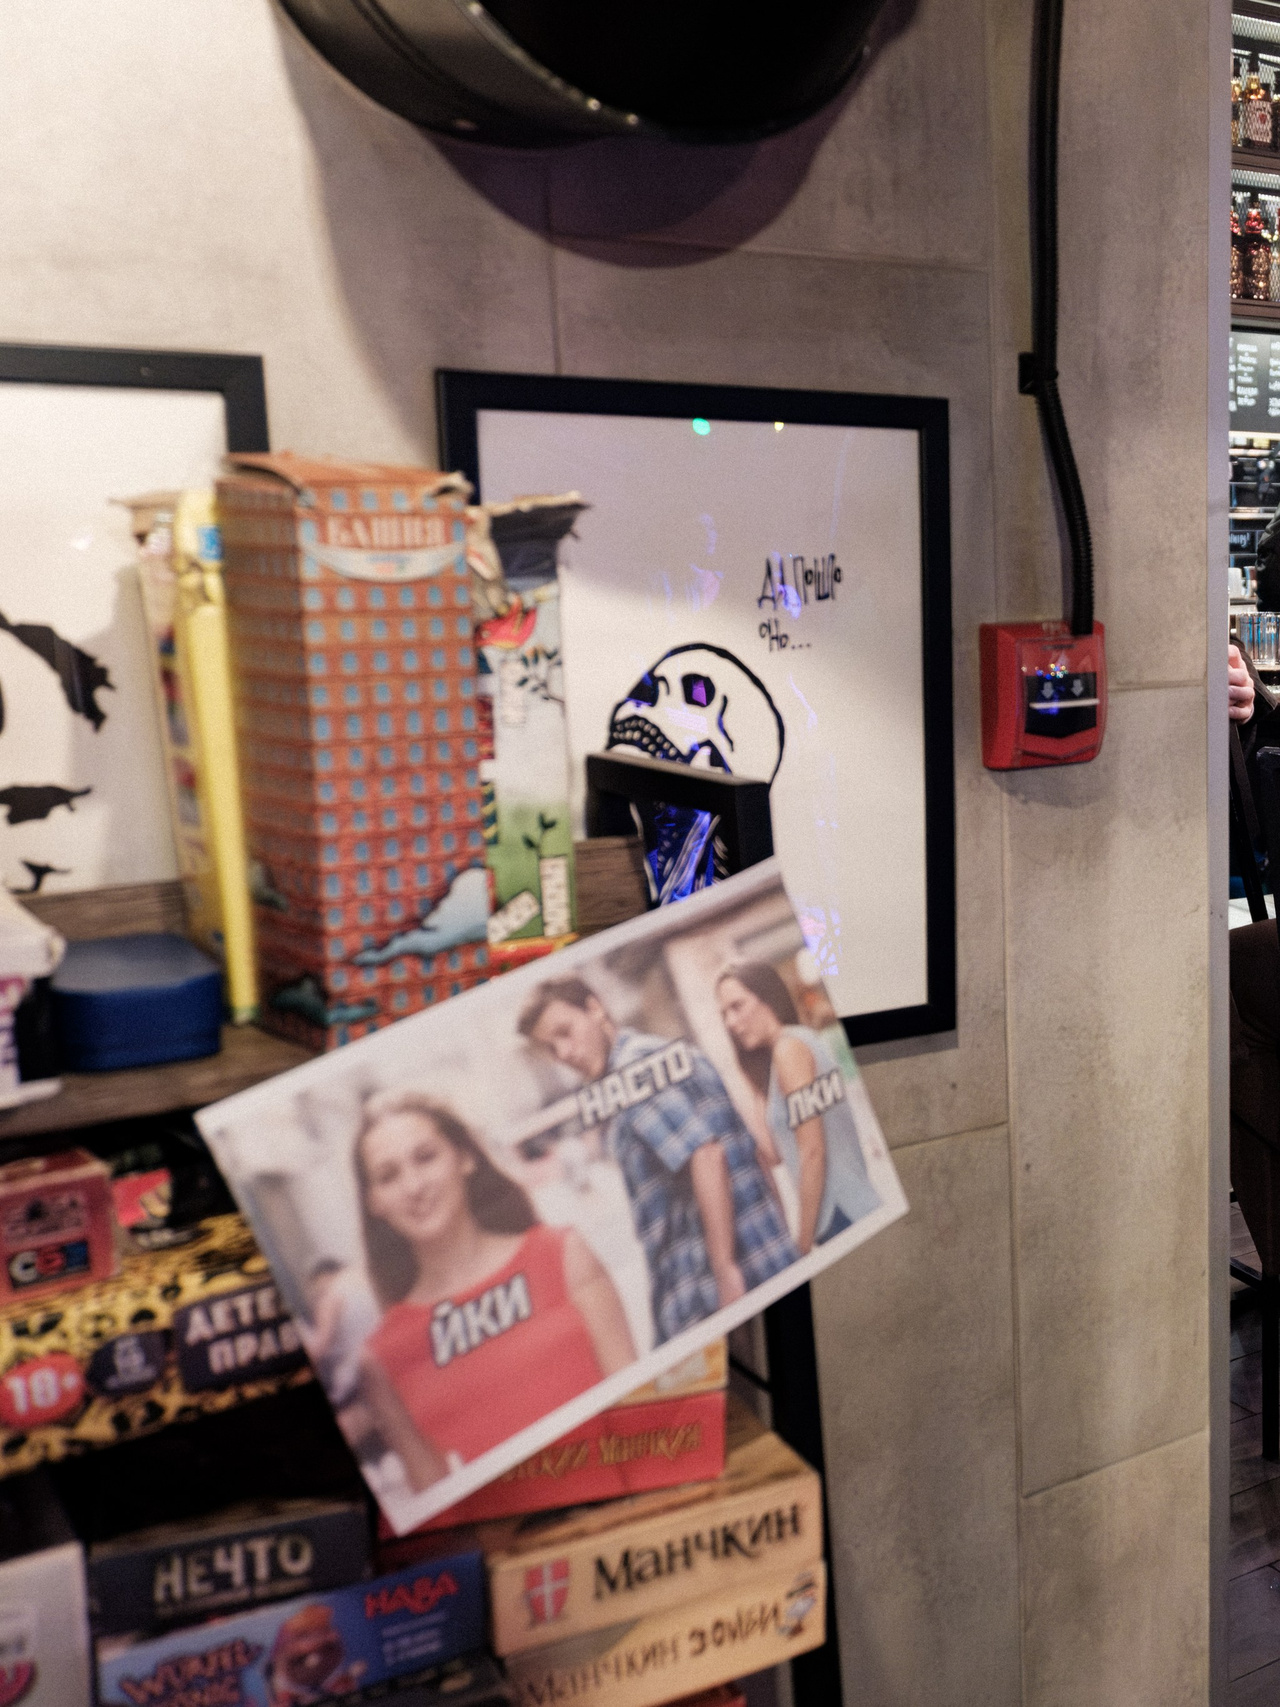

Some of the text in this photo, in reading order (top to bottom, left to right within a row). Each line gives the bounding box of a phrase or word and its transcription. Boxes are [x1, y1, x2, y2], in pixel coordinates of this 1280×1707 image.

[577, 1042, 694, 1127] НАСТО
[786, 1069, 845, 1130] ЛКИ
[430, 1272, 532, 1367] ЙКИ
[153, 1533, 314, 1605] НЕЧТО
[364, 1570, 460, 1620] HABA
